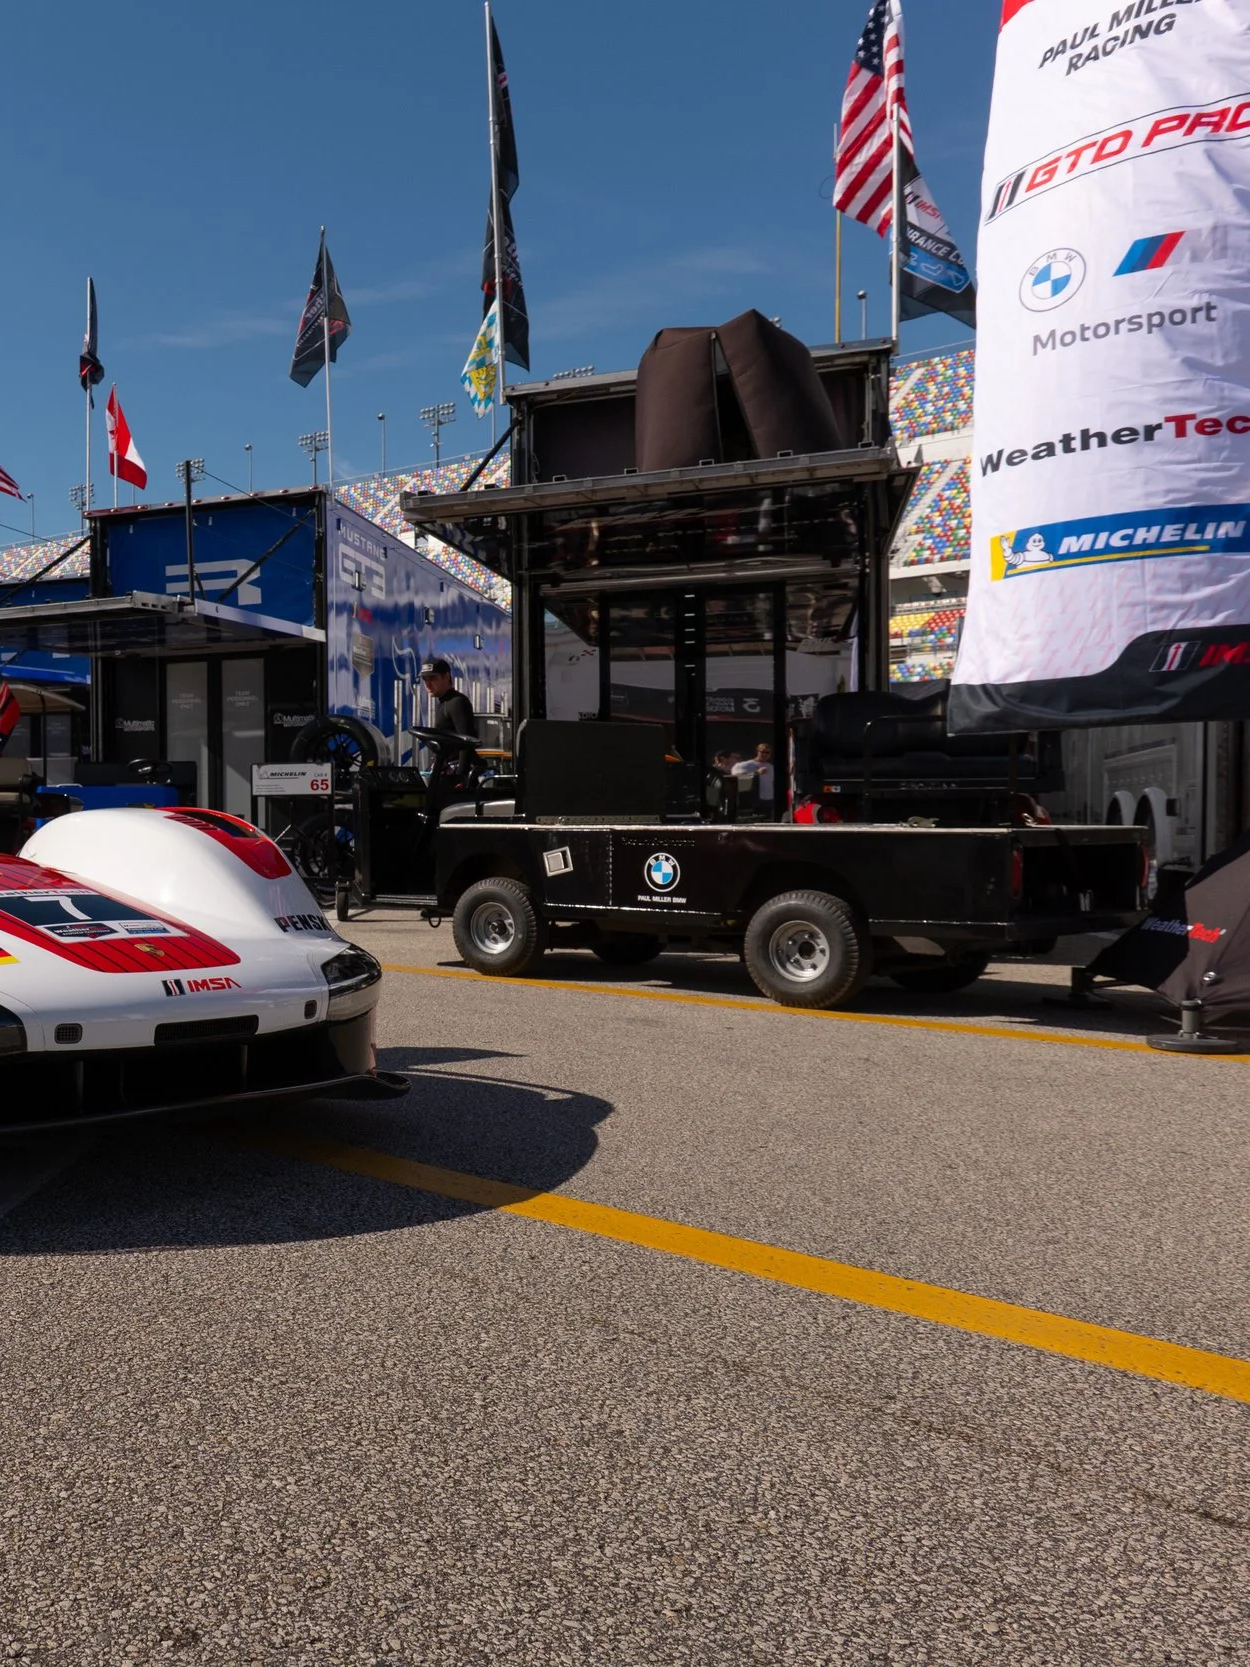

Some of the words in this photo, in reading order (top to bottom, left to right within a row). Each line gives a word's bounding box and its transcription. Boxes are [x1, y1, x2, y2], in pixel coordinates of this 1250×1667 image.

[1038, 23, 1100, 69] PAUL
[1065, 13, 1177, 76] RACING
[1025, 130, 1133, 193] GTD
[1032, 301, 1218, 356] Motorsport
[1057, 519, 1248, 556] MICHELIN
[310, 779, 329, 791] 65
[23, 896, 93, 920] 7
[1142, 917, 1221, 944] WeatherTech
[187, 977, 242, 993] IMSA
